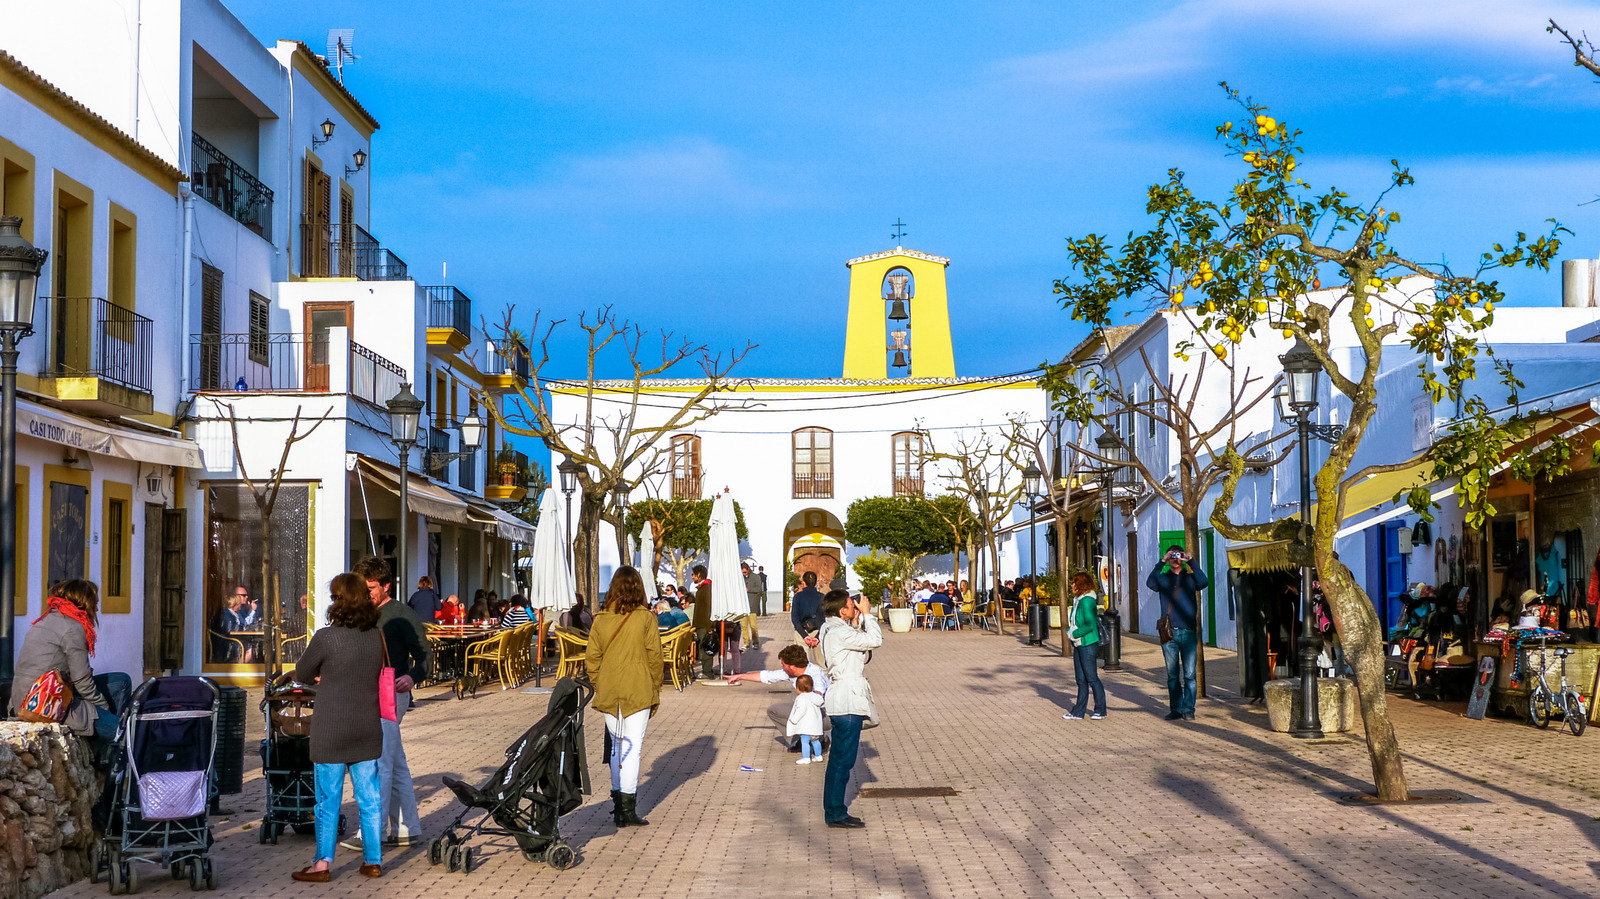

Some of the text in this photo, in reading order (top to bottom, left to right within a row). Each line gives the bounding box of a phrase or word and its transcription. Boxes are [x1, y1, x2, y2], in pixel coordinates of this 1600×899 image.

[30, 420, 46, 437] CASI
[47, 424, 65, 443] TODO
[53, 502, 67, 529] CASI
